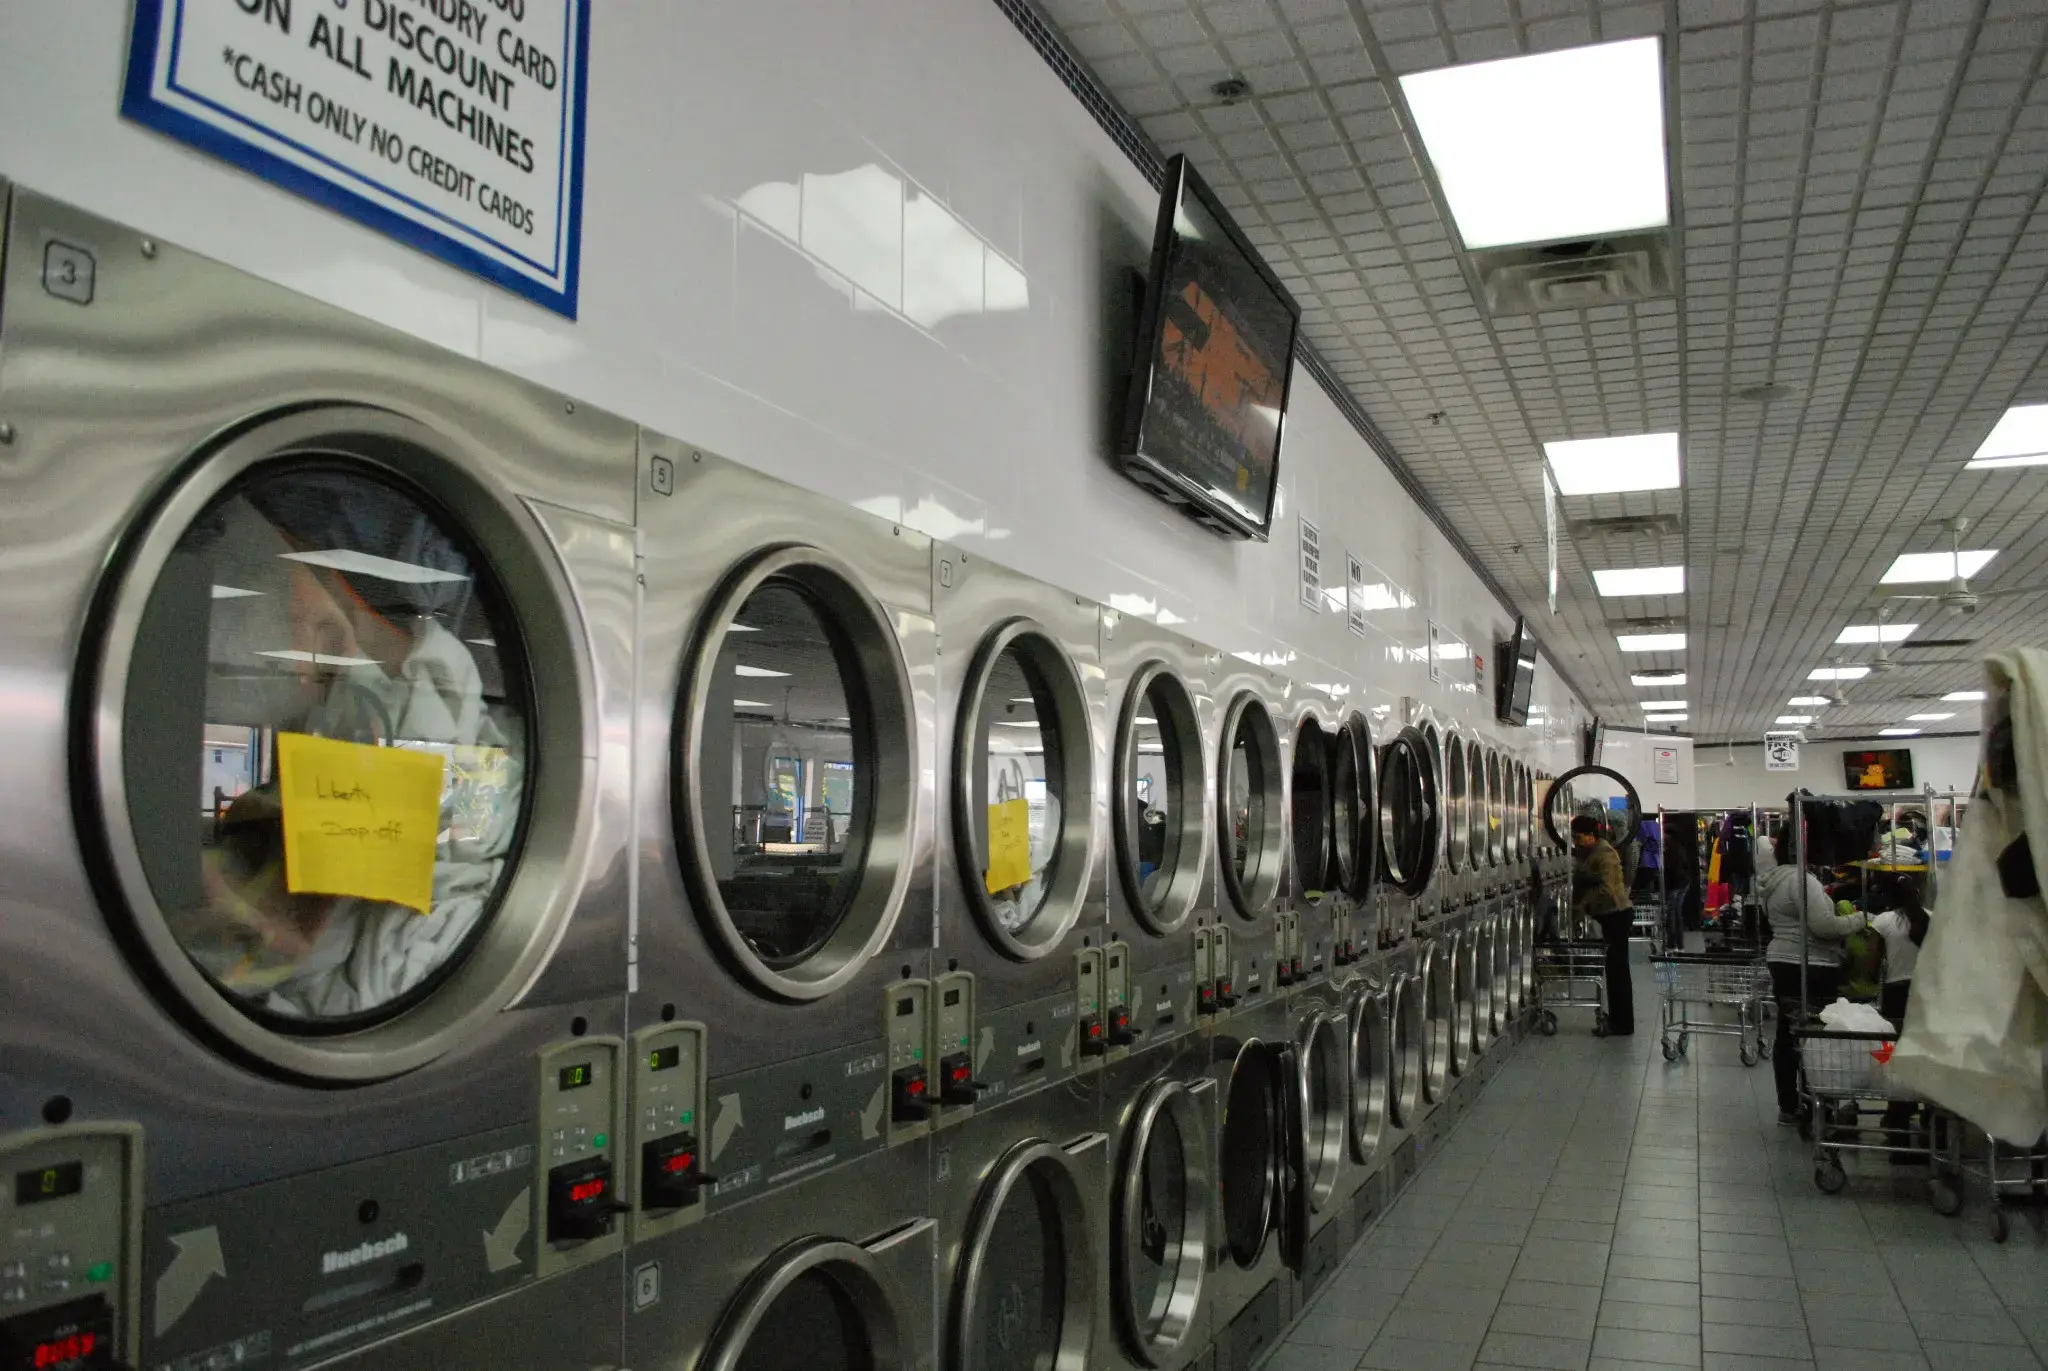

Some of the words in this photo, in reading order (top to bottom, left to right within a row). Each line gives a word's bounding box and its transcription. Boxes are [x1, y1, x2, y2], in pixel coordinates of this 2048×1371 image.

[364, 0, 515, 111] DISCOUNT
[497, 27, 557, 91] CARD
[308, 13, 372, 81] ALL
[387, 55, 534, 174] MACHINES
[306, 91, 367, 145] ONLY
[370, 122, 404, 164] NO
[407, 145, 475, 202] CREDIT
[478, 183, 534, 236] CARDS
[61, 259, 77, 285] 3
[658, 467, 666, 484] 5
[784, 1106, 825, 1130] Huebsch
[322, 1232, 408, 1274] Huebsch
[643, 1278, 651, 1296] 6
